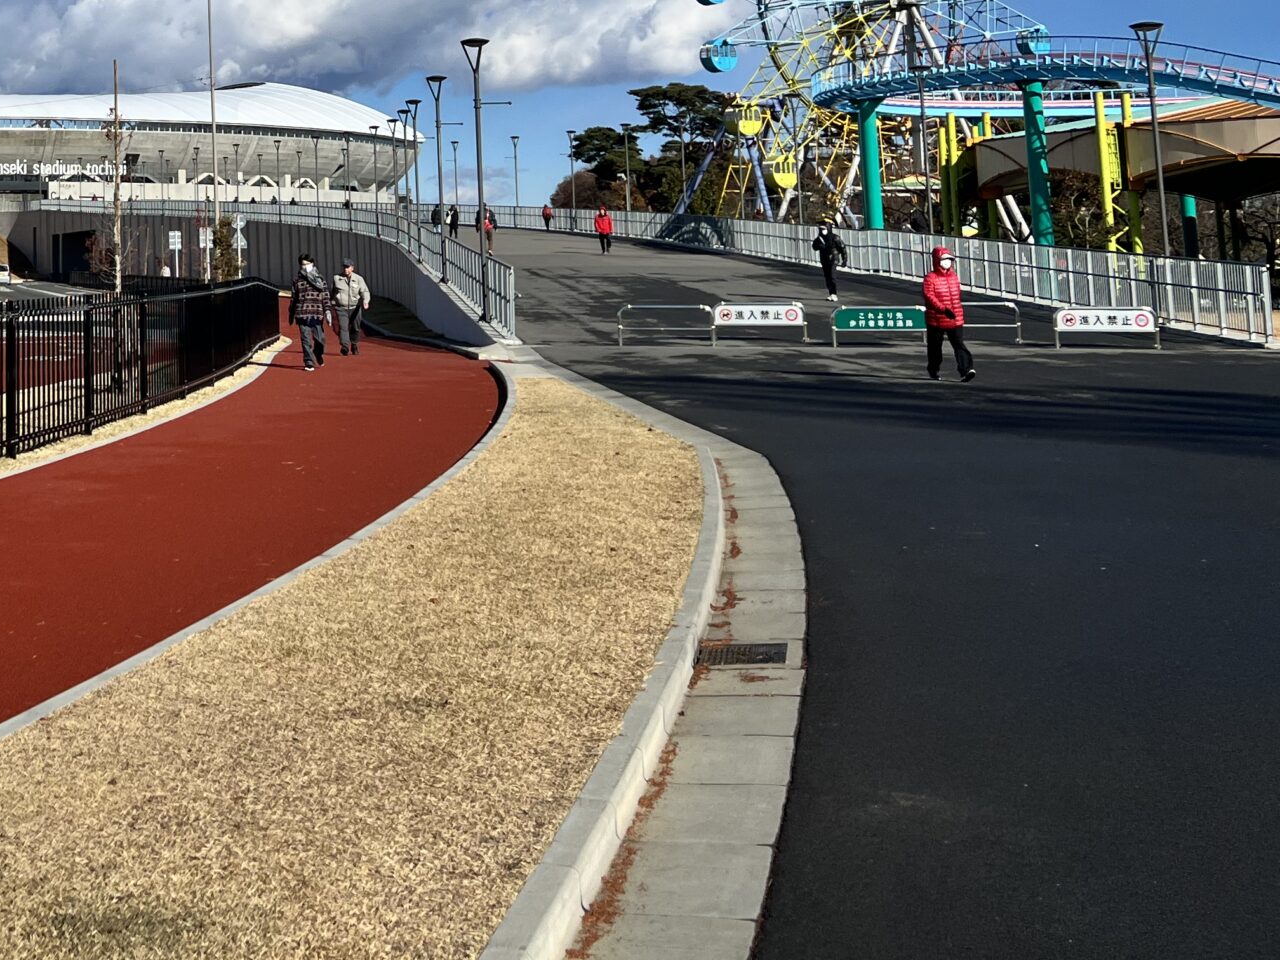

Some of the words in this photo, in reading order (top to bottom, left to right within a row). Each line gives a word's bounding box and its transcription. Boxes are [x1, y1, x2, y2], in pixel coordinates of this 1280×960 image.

[32, 159, 82, 175] stadium
[734, 310, 783, 321] 進入禁止
[858, 312, 904, 320] これより先
[1078, 315, 1132, 326] 進入禁止
